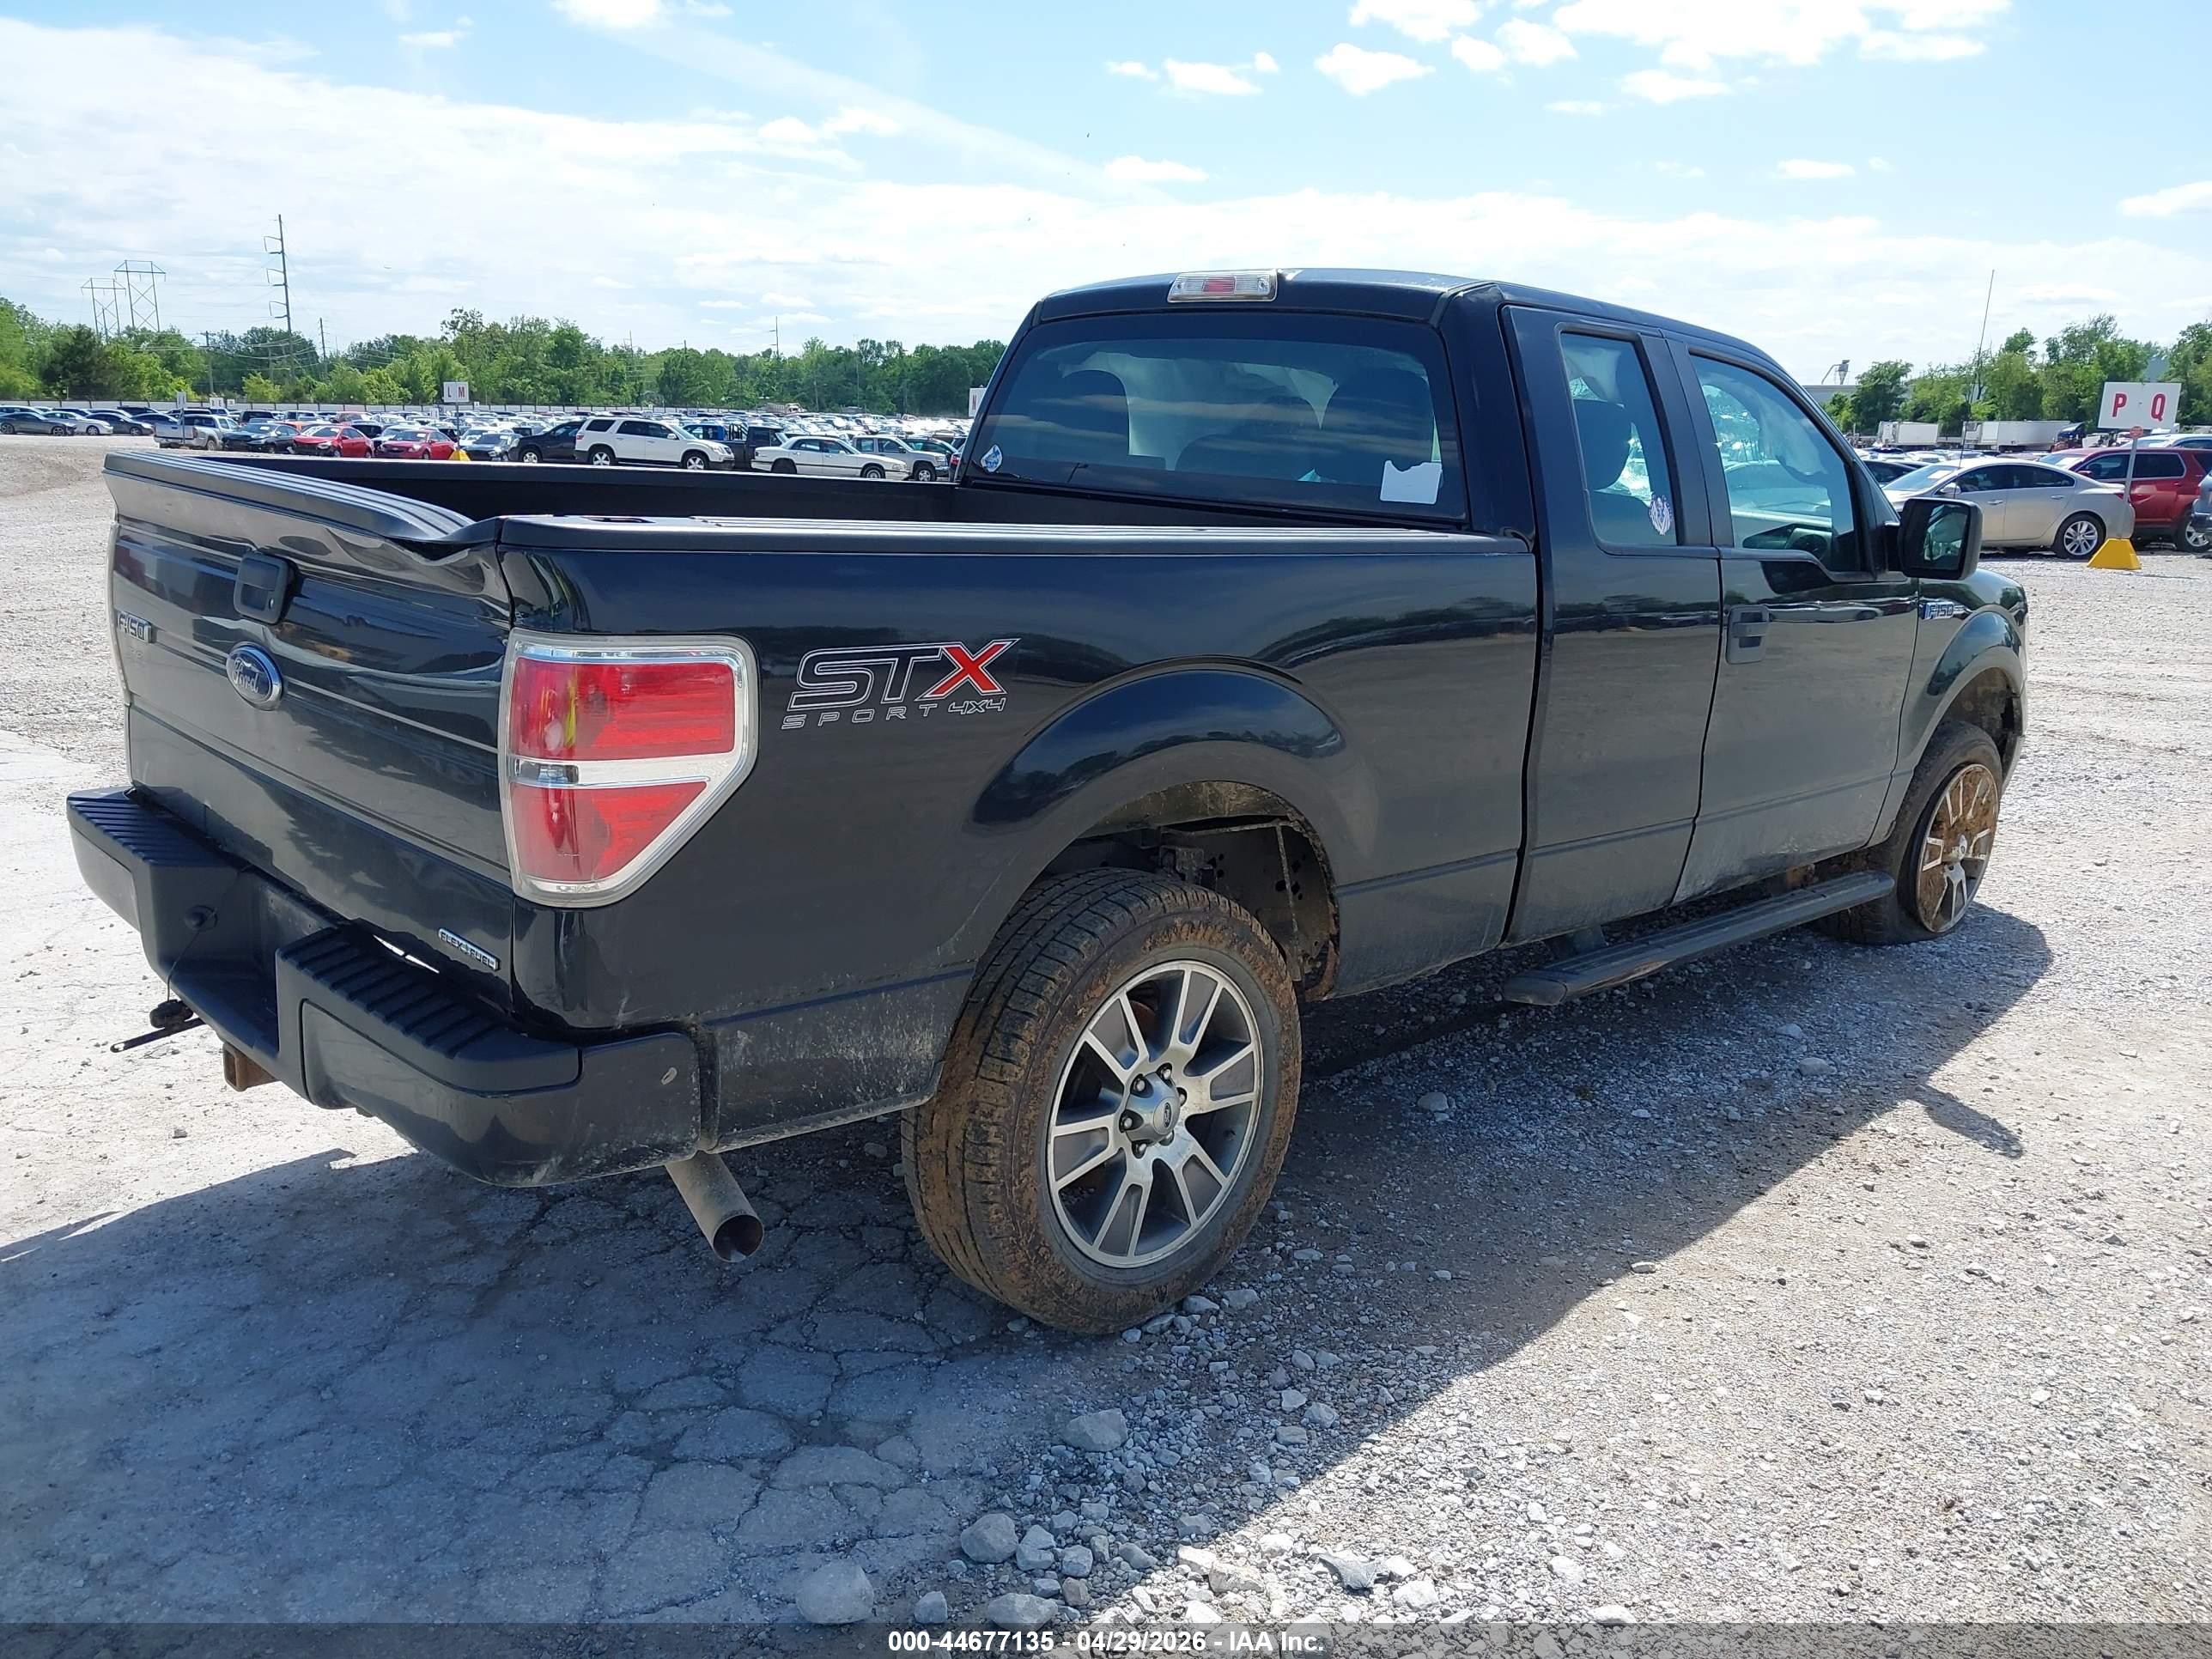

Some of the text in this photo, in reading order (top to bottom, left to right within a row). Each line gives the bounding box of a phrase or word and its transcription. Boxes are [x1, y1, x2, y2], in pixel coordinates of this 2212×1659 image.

[458, 386, 465, 398] M
[2112, 393, 2166, 422] P Q
[233, 657, 264, 693] Ford
[787, 637, 1022, 712] STX
[781, 702, 939, 730] SPORT
[441, 932, 495, 970] FLEX FUEL
